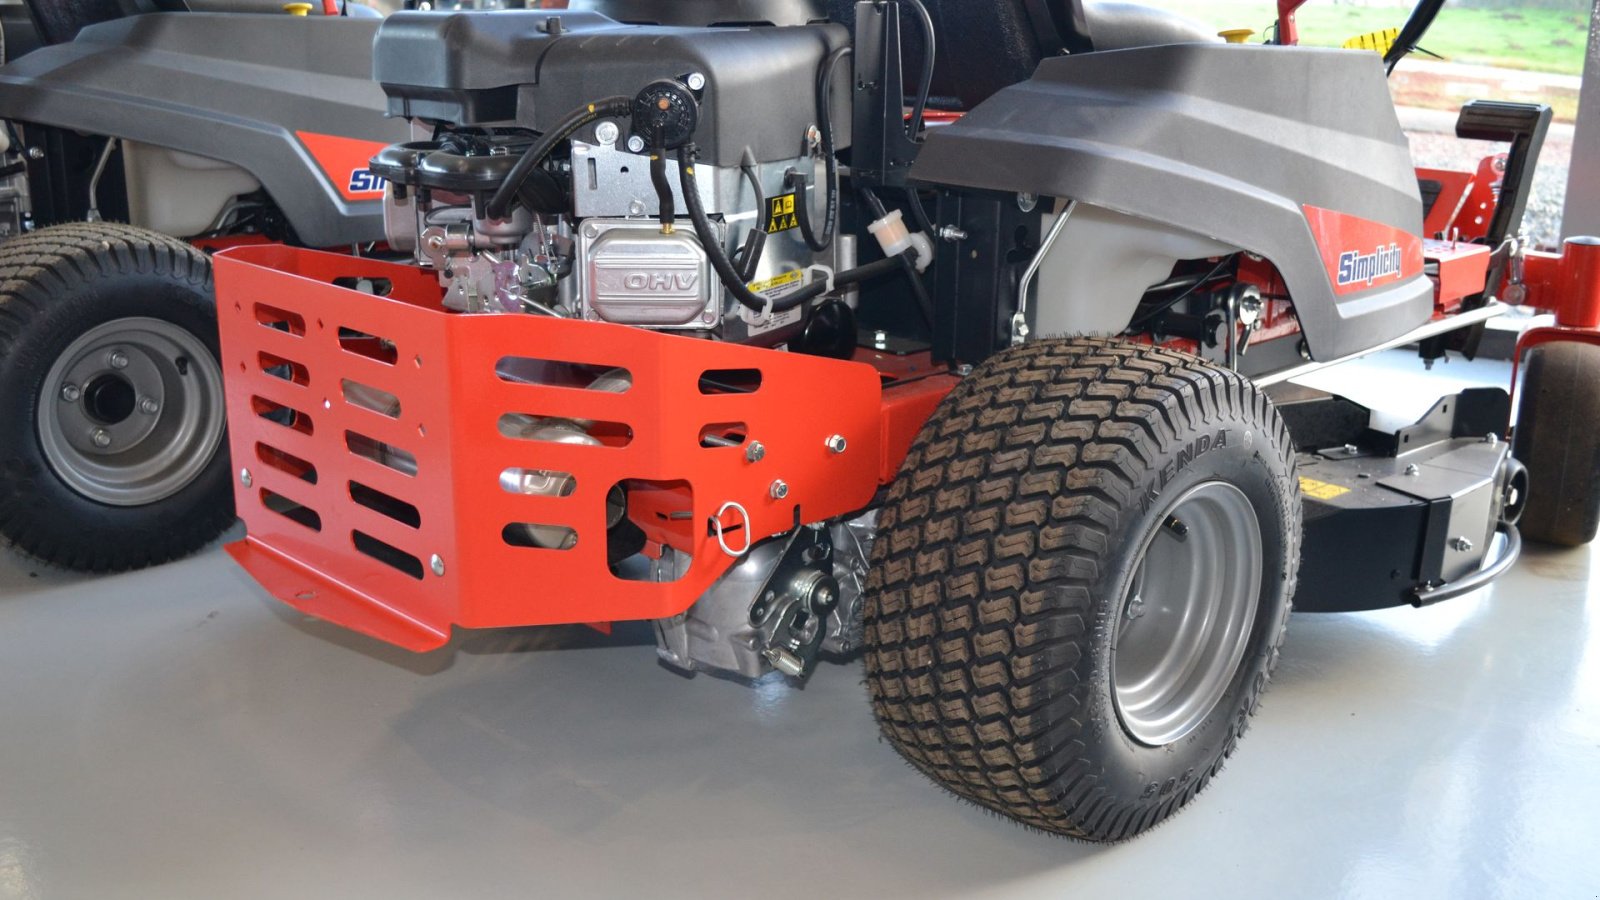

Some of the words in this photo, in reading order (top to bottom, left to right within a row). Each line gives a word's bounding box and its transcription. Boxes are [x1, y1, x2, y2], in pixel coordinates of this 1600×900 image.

[624, 271, 697, 290] OHV
[1338, 243, 1402, 286] Simplicity
[1140, 428, 1228, 516] KENDA
